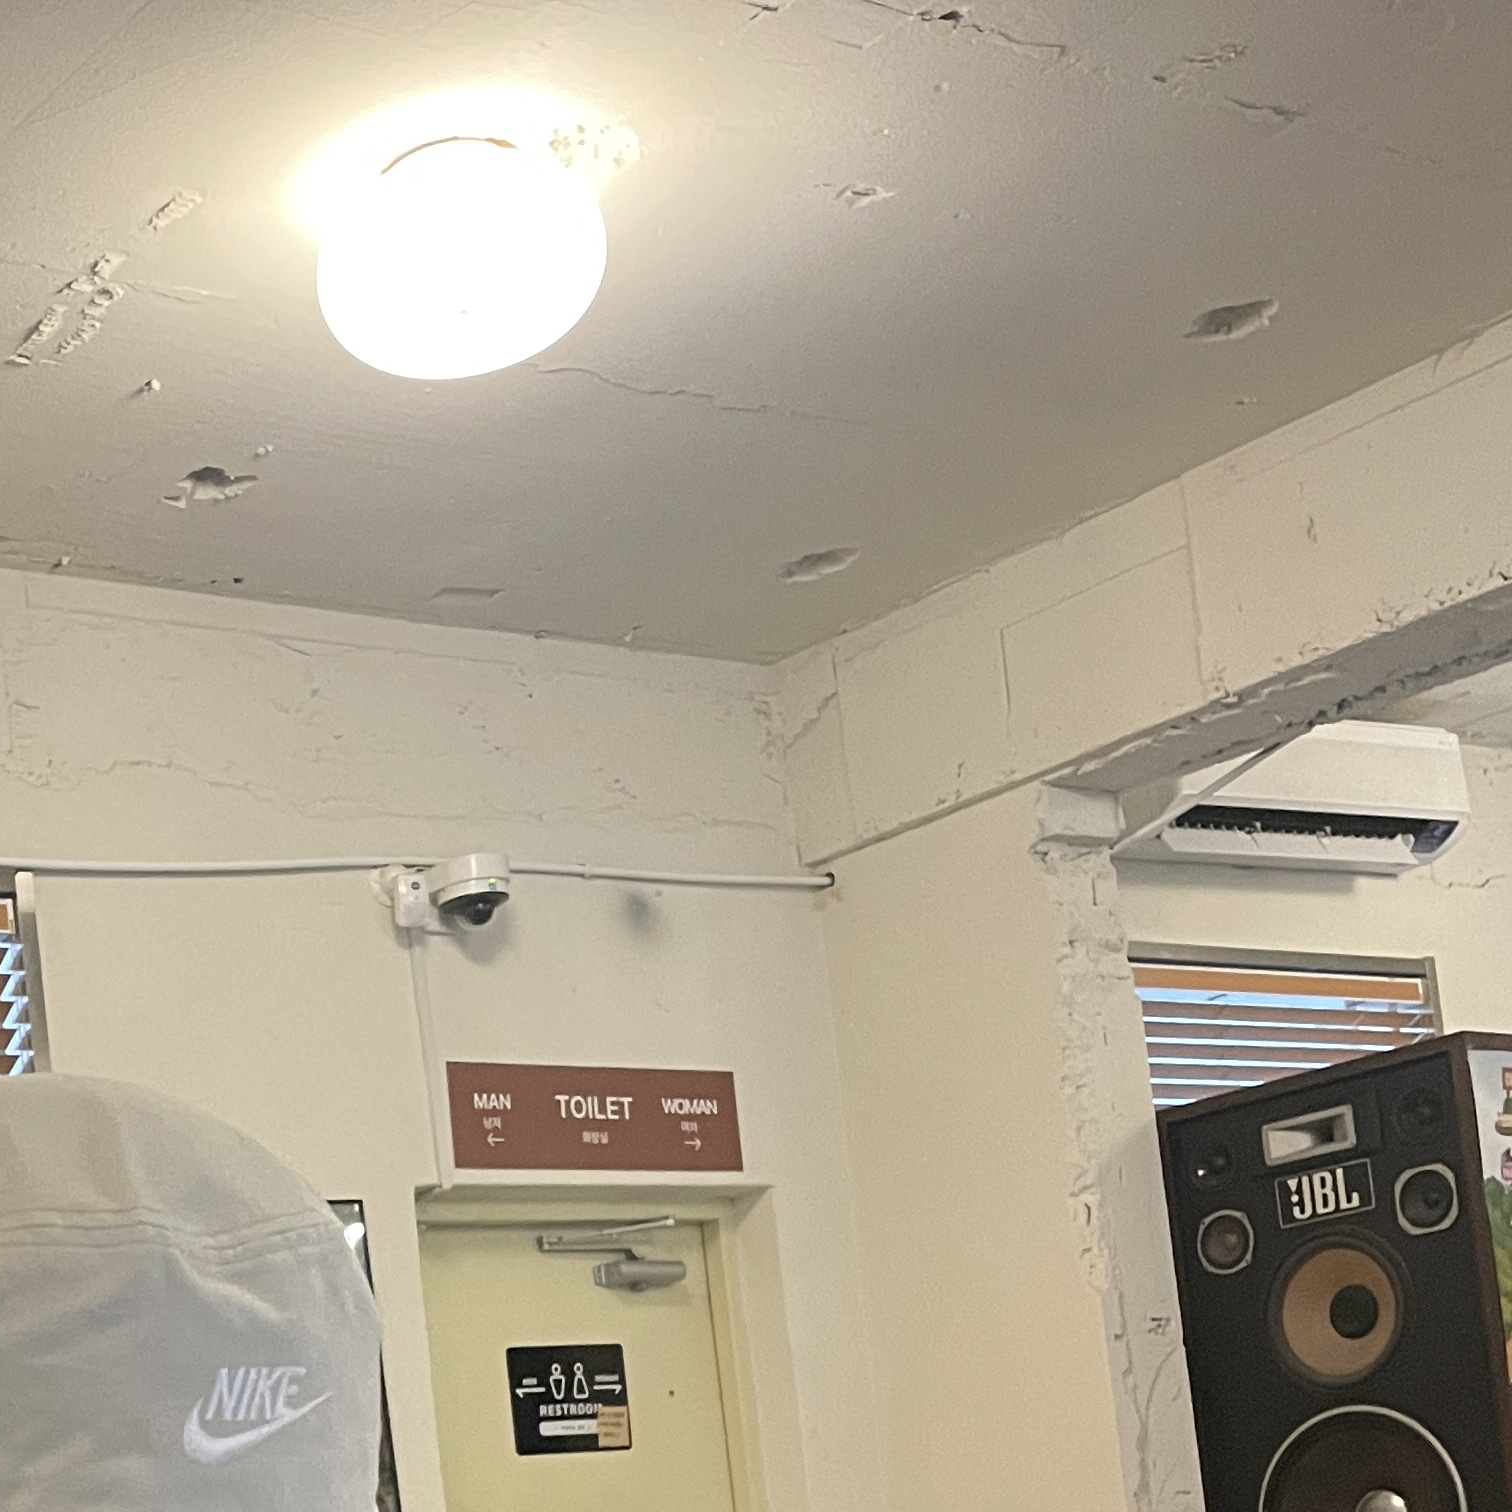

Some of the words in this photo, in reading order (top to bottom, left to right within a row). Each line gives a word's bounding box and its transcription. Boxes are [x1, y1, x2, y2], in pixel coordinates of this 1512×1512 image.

[474, 1093, 511, 1109] MAN
[555, 1095, 633, 1120] TOILET
[661, 1098, 718, 1115] WOMAN
[1288, 1167, 1360, 1219] JBL
[205, 1366, 307, 1420] NIKE
